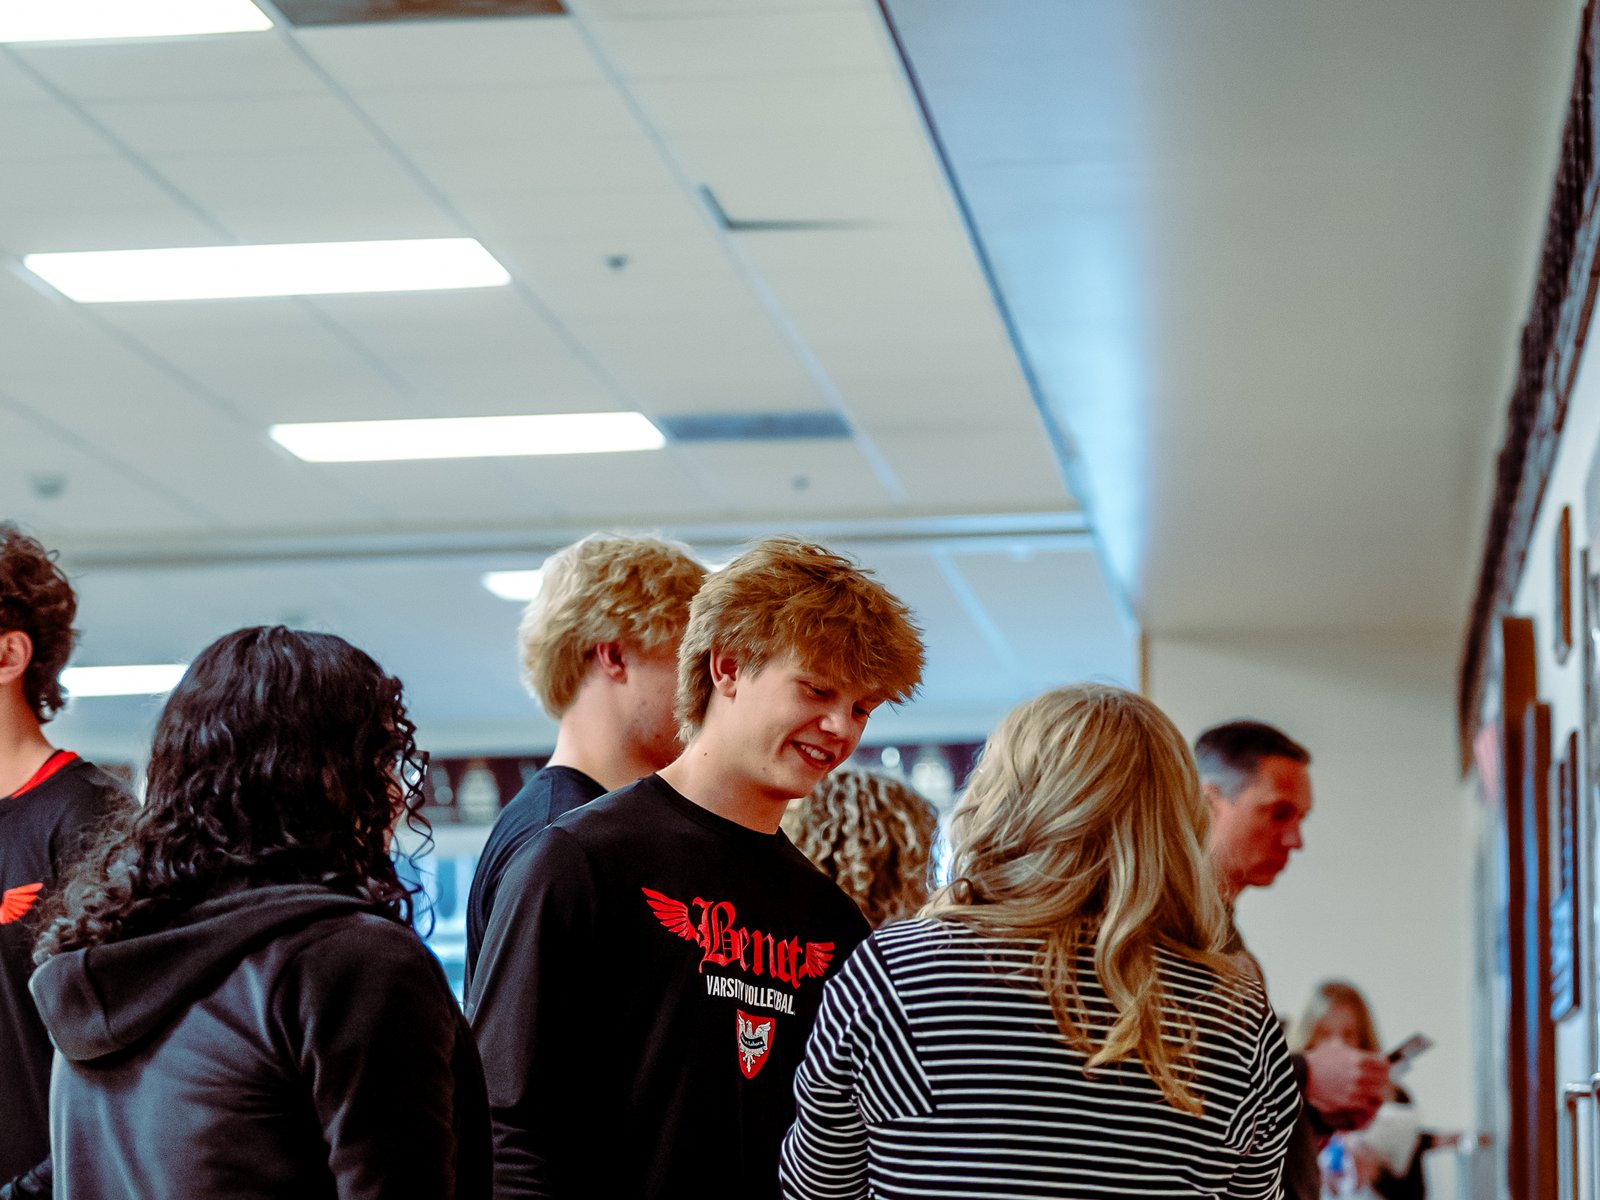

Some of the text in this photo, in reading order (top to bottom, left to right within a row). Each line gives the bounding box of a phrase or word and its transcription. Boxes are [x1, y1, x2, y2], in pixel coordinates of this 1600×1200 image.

[692, 897, 803, 989] Benet
[706, 974, 796, 1016] VARSITY VOLLEYBAL
